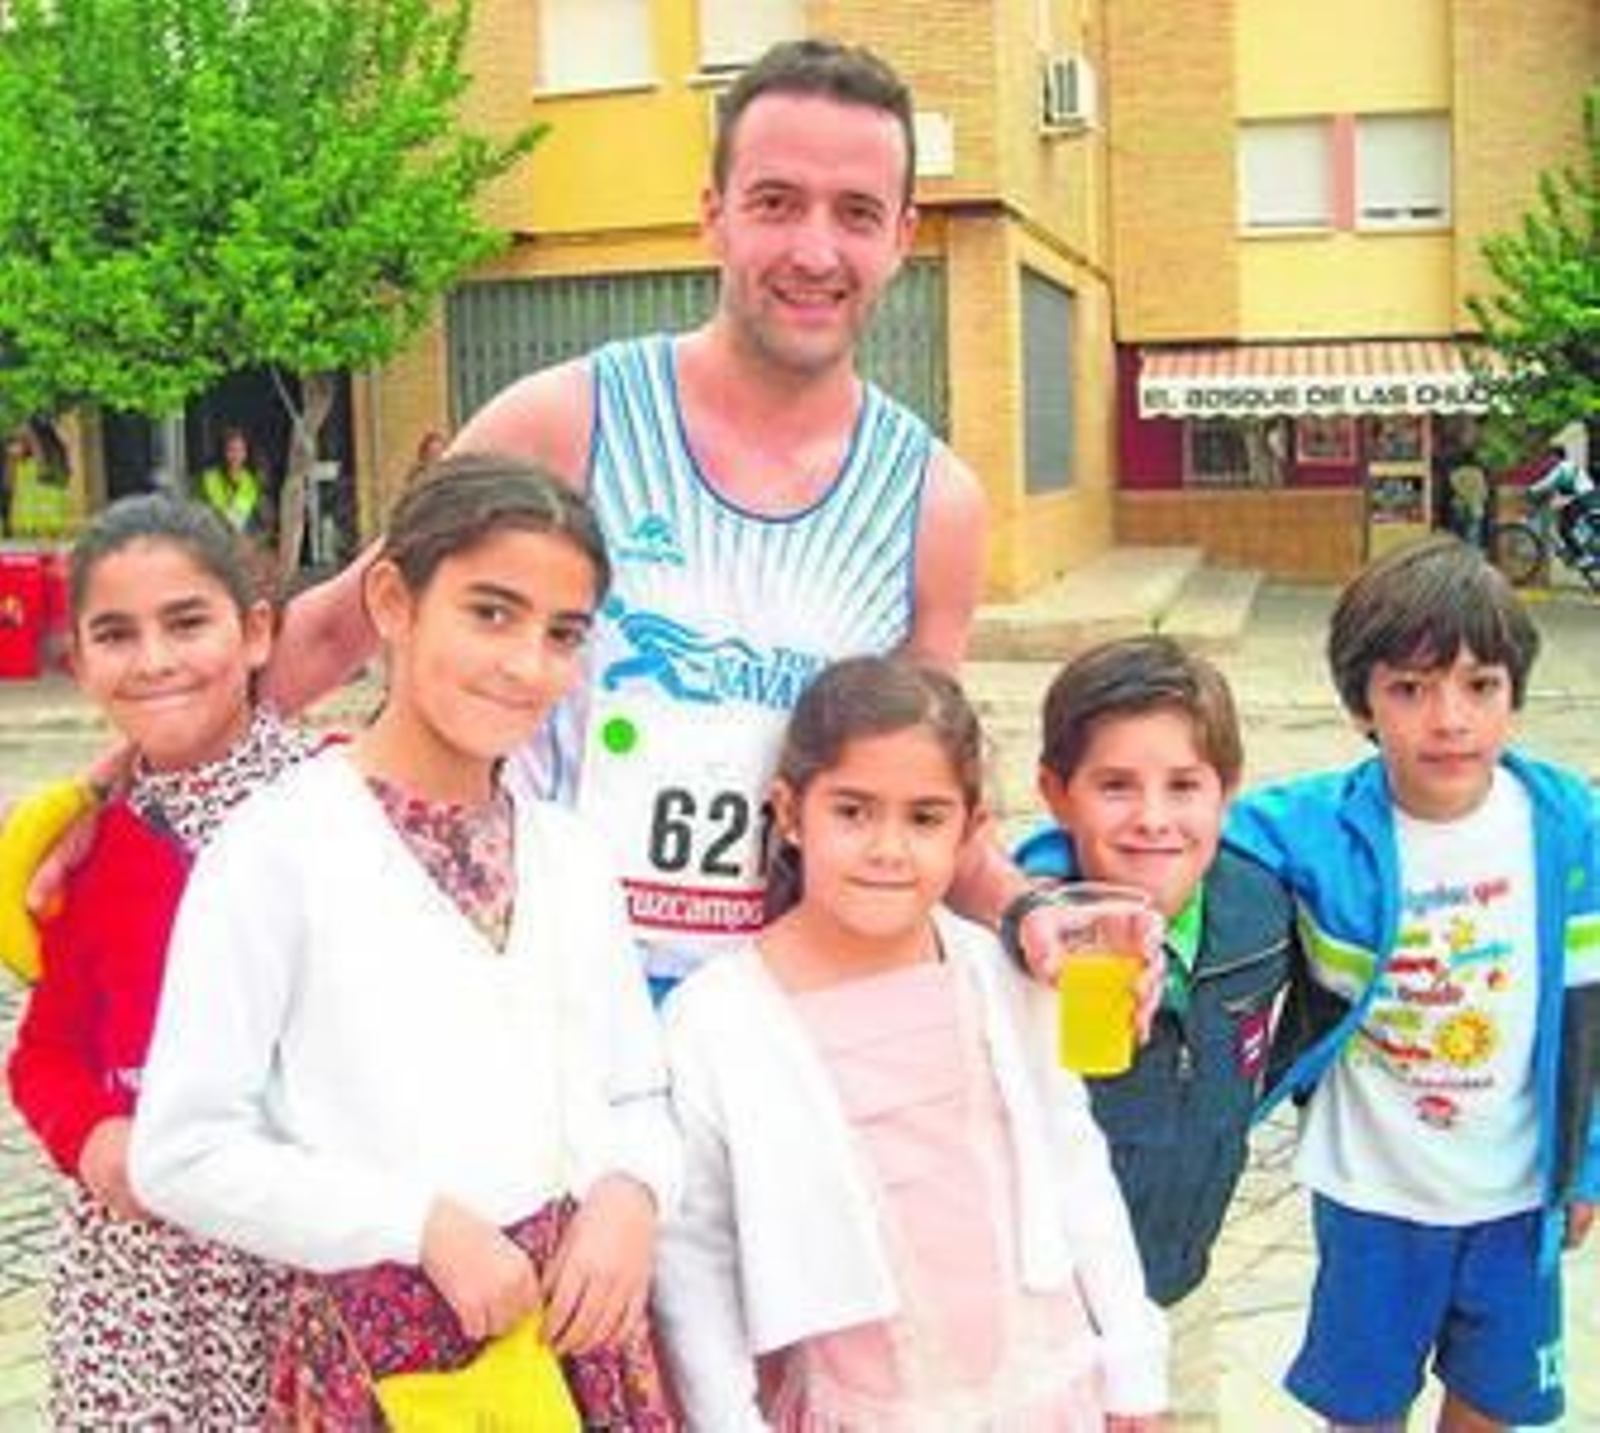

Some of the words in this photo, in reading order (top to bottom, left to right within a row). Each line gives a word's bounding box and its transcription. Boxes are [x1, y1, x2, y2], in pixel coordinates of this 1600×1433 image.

[1143, 388, 1178, 409] EL
[1186, 386, 1298, 409] BOSQUE
[1306, 385, 1345, 406] DE
[1354, 384, 1408, 405] LAS
